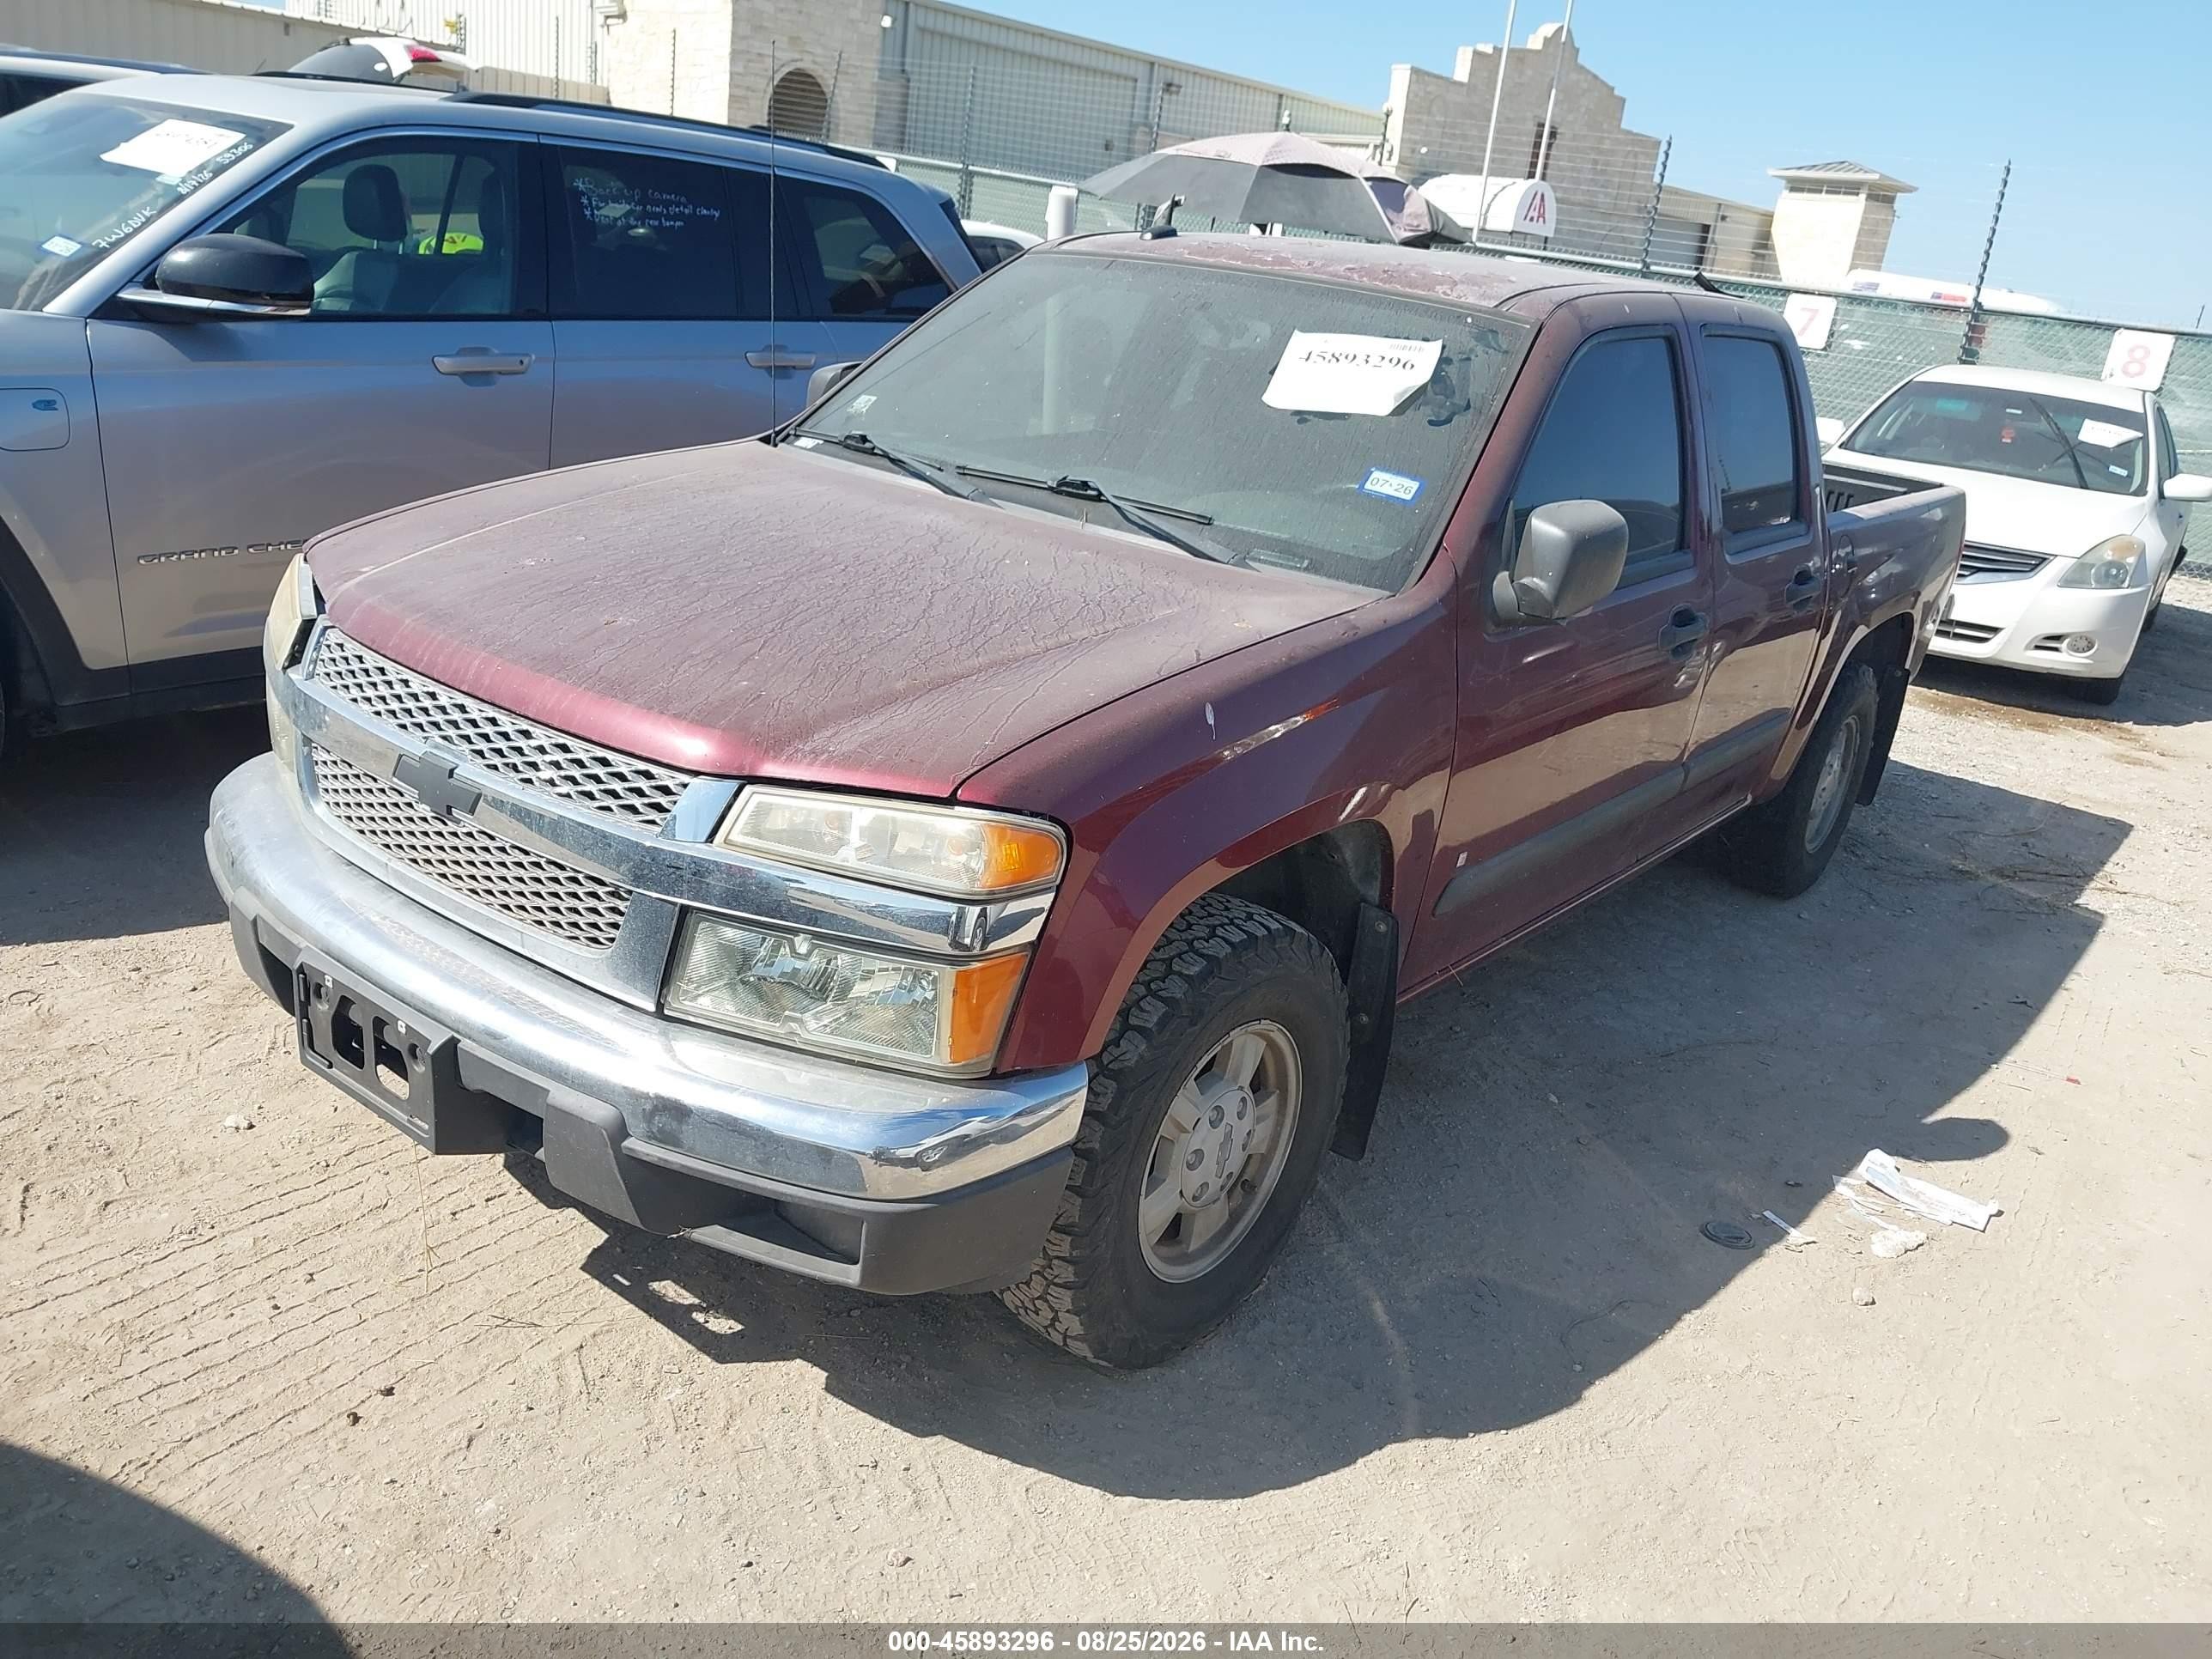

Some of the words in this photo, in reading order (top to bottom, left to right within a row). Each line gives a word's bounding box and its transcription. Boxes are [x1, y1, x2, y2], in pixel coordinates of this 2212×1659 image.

[1797, 307, 1820, 337] 7
[1299, 349, 1415, 371] 45893296
[2121, 343, 2151, 379] 8
[137, 545, 239, 565] GRAND
